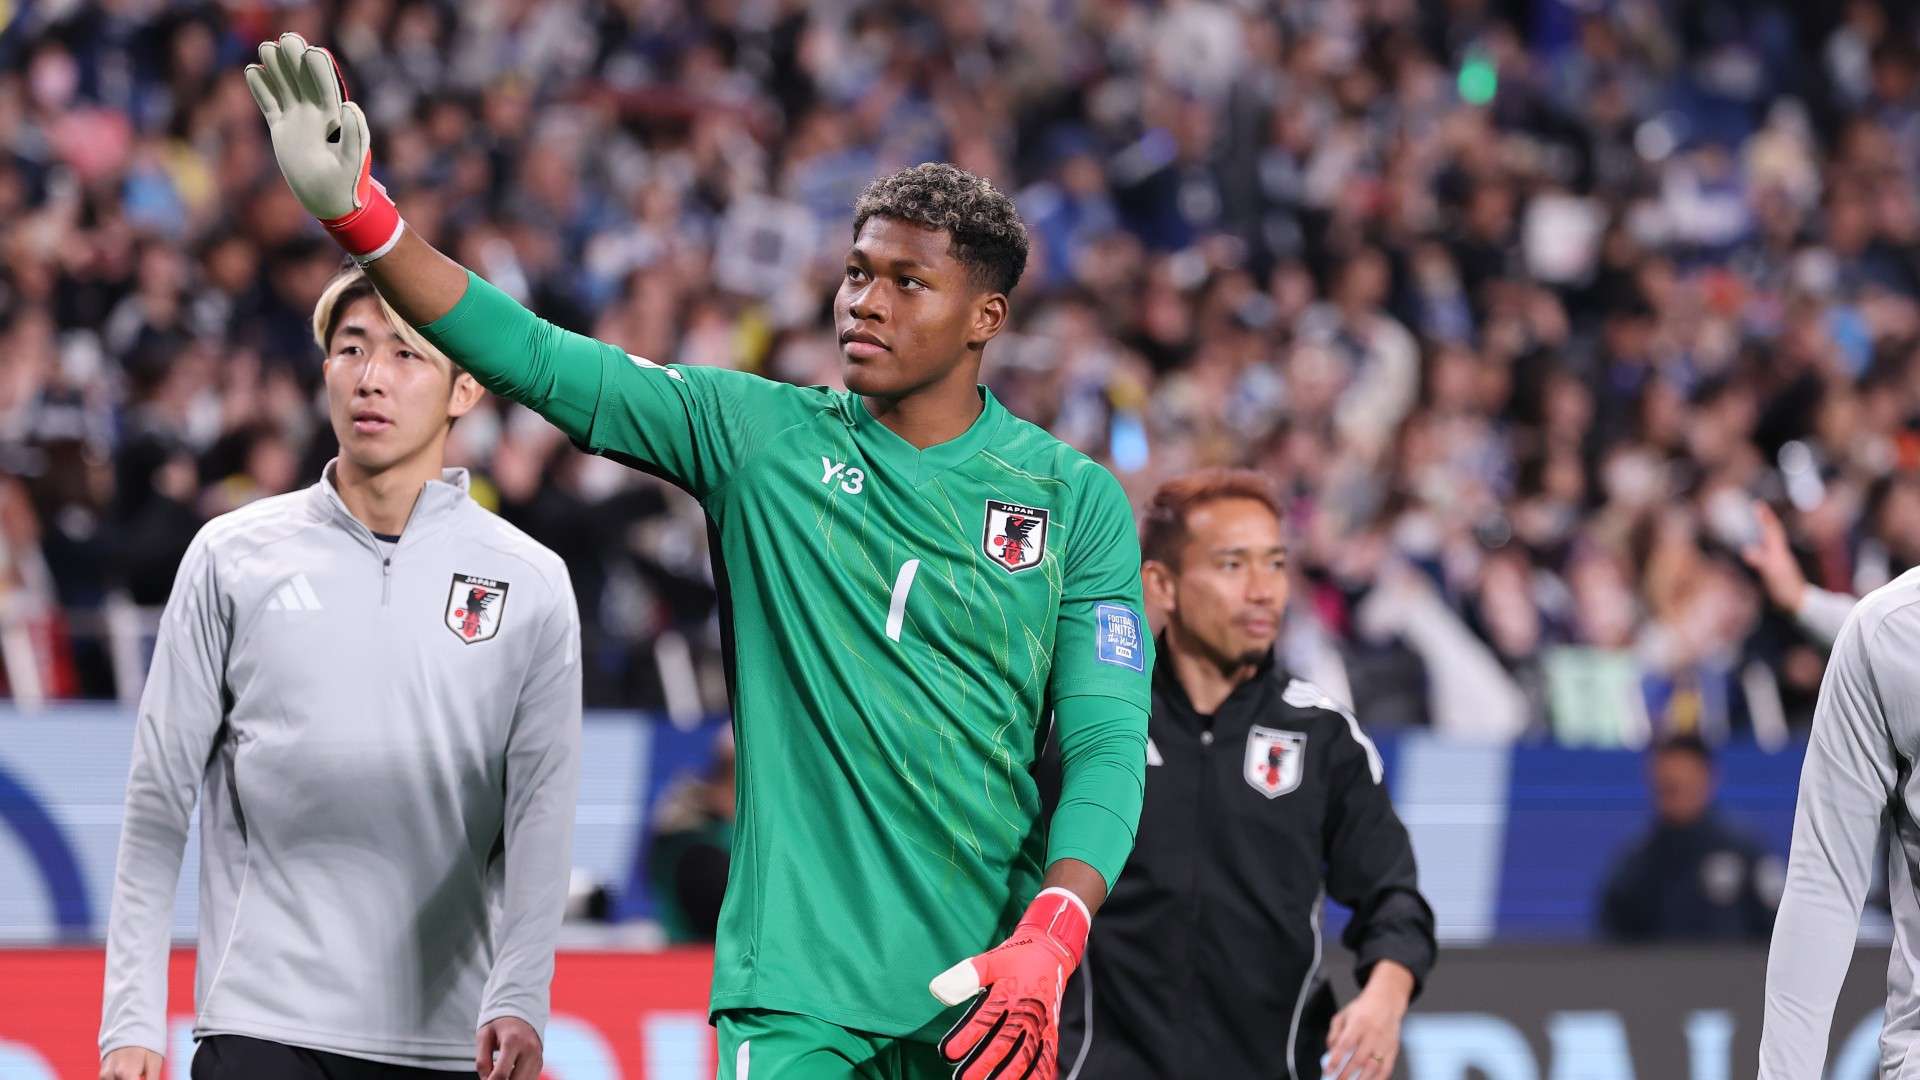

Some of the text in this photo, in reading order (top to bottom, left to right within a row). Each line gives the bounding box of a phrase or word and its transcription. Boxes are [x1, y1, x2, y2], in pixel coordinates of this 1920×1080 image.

[821, 456, 865, 494] Y-3
[1001, 504, 1034, 515] JAPAN
[464, 576, 497, 587] JAPAN
[885, 558, 920, 643] 1
[1108, 622, 1137, 640] UNITES
